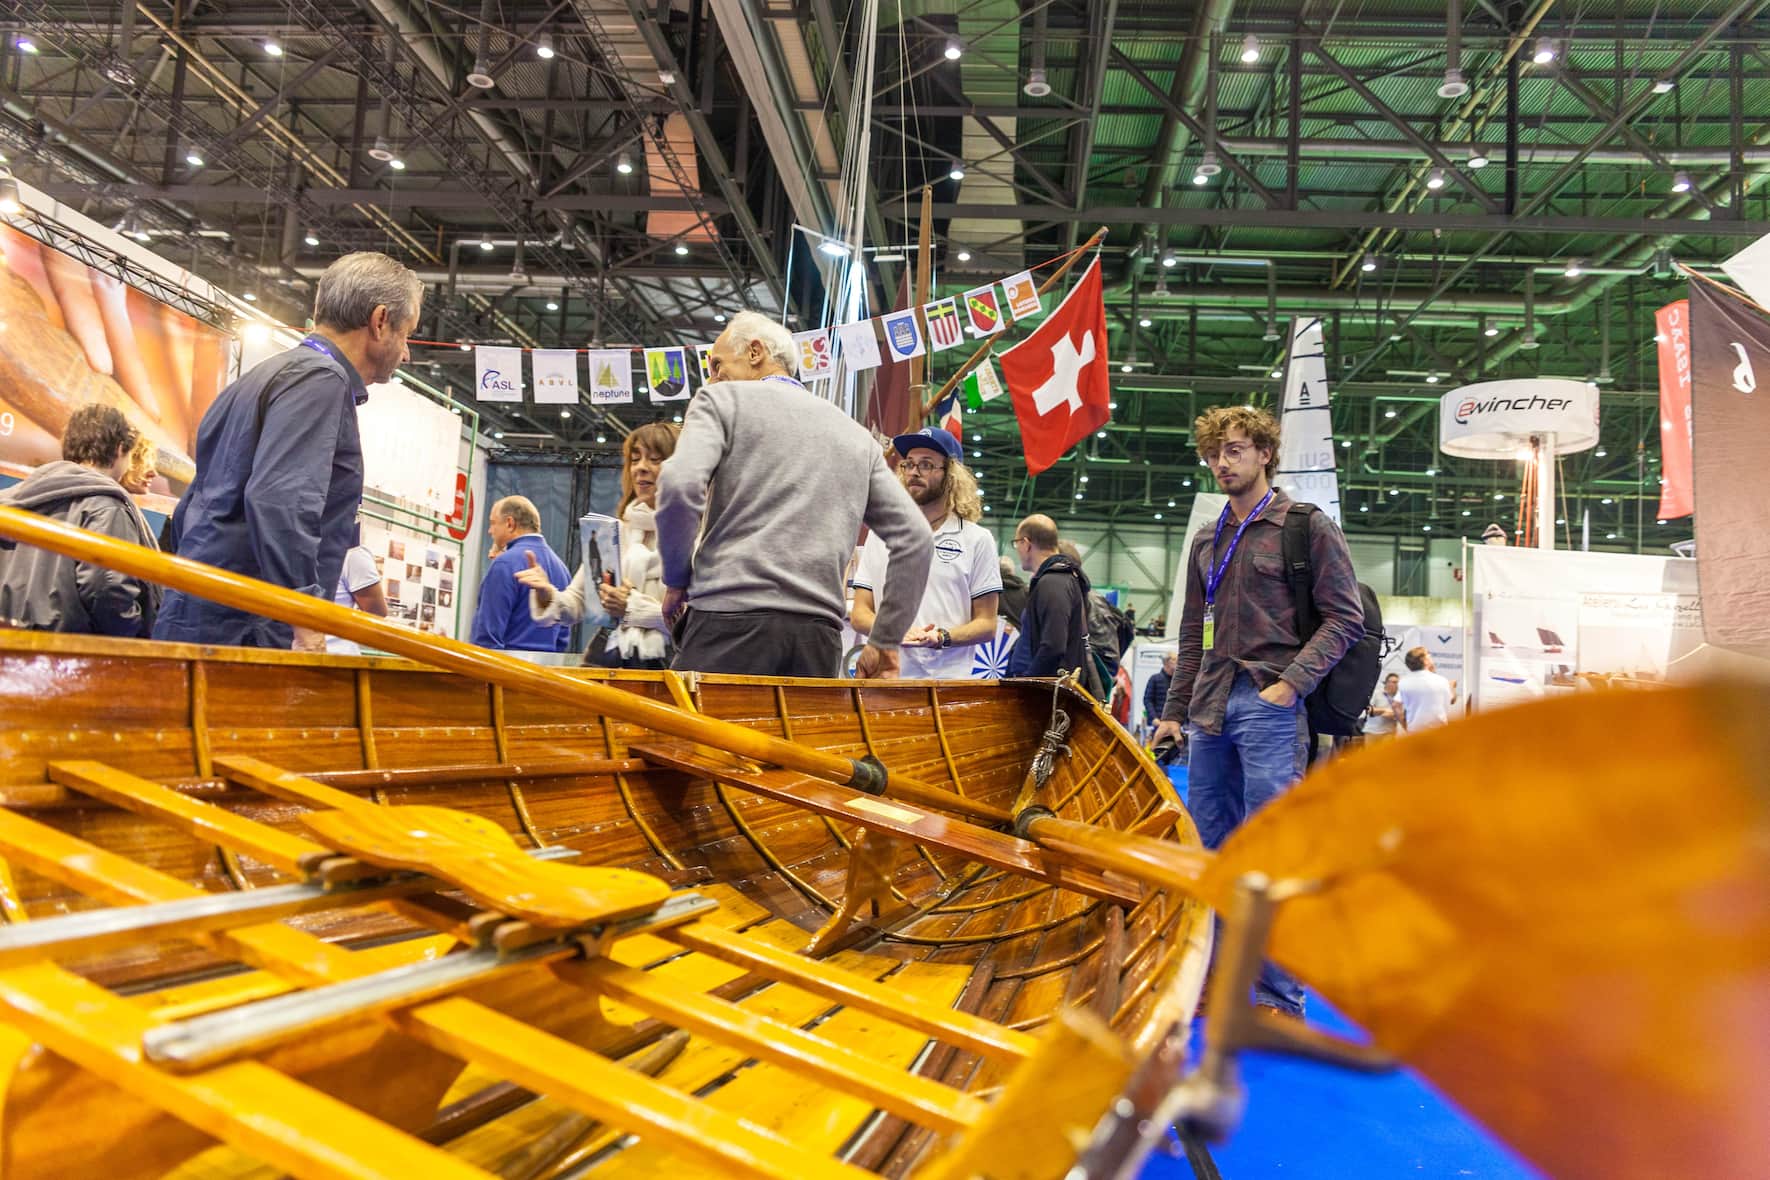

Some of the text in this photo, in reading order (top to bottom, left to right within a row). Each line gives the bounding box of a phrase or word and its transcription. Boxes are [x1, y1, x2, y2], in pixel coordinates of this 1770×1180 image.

[491, 380, 515, 391] ASL
[592, 389, 630, 401] neptune
[1457, 395, 1573, 418] ewincher
